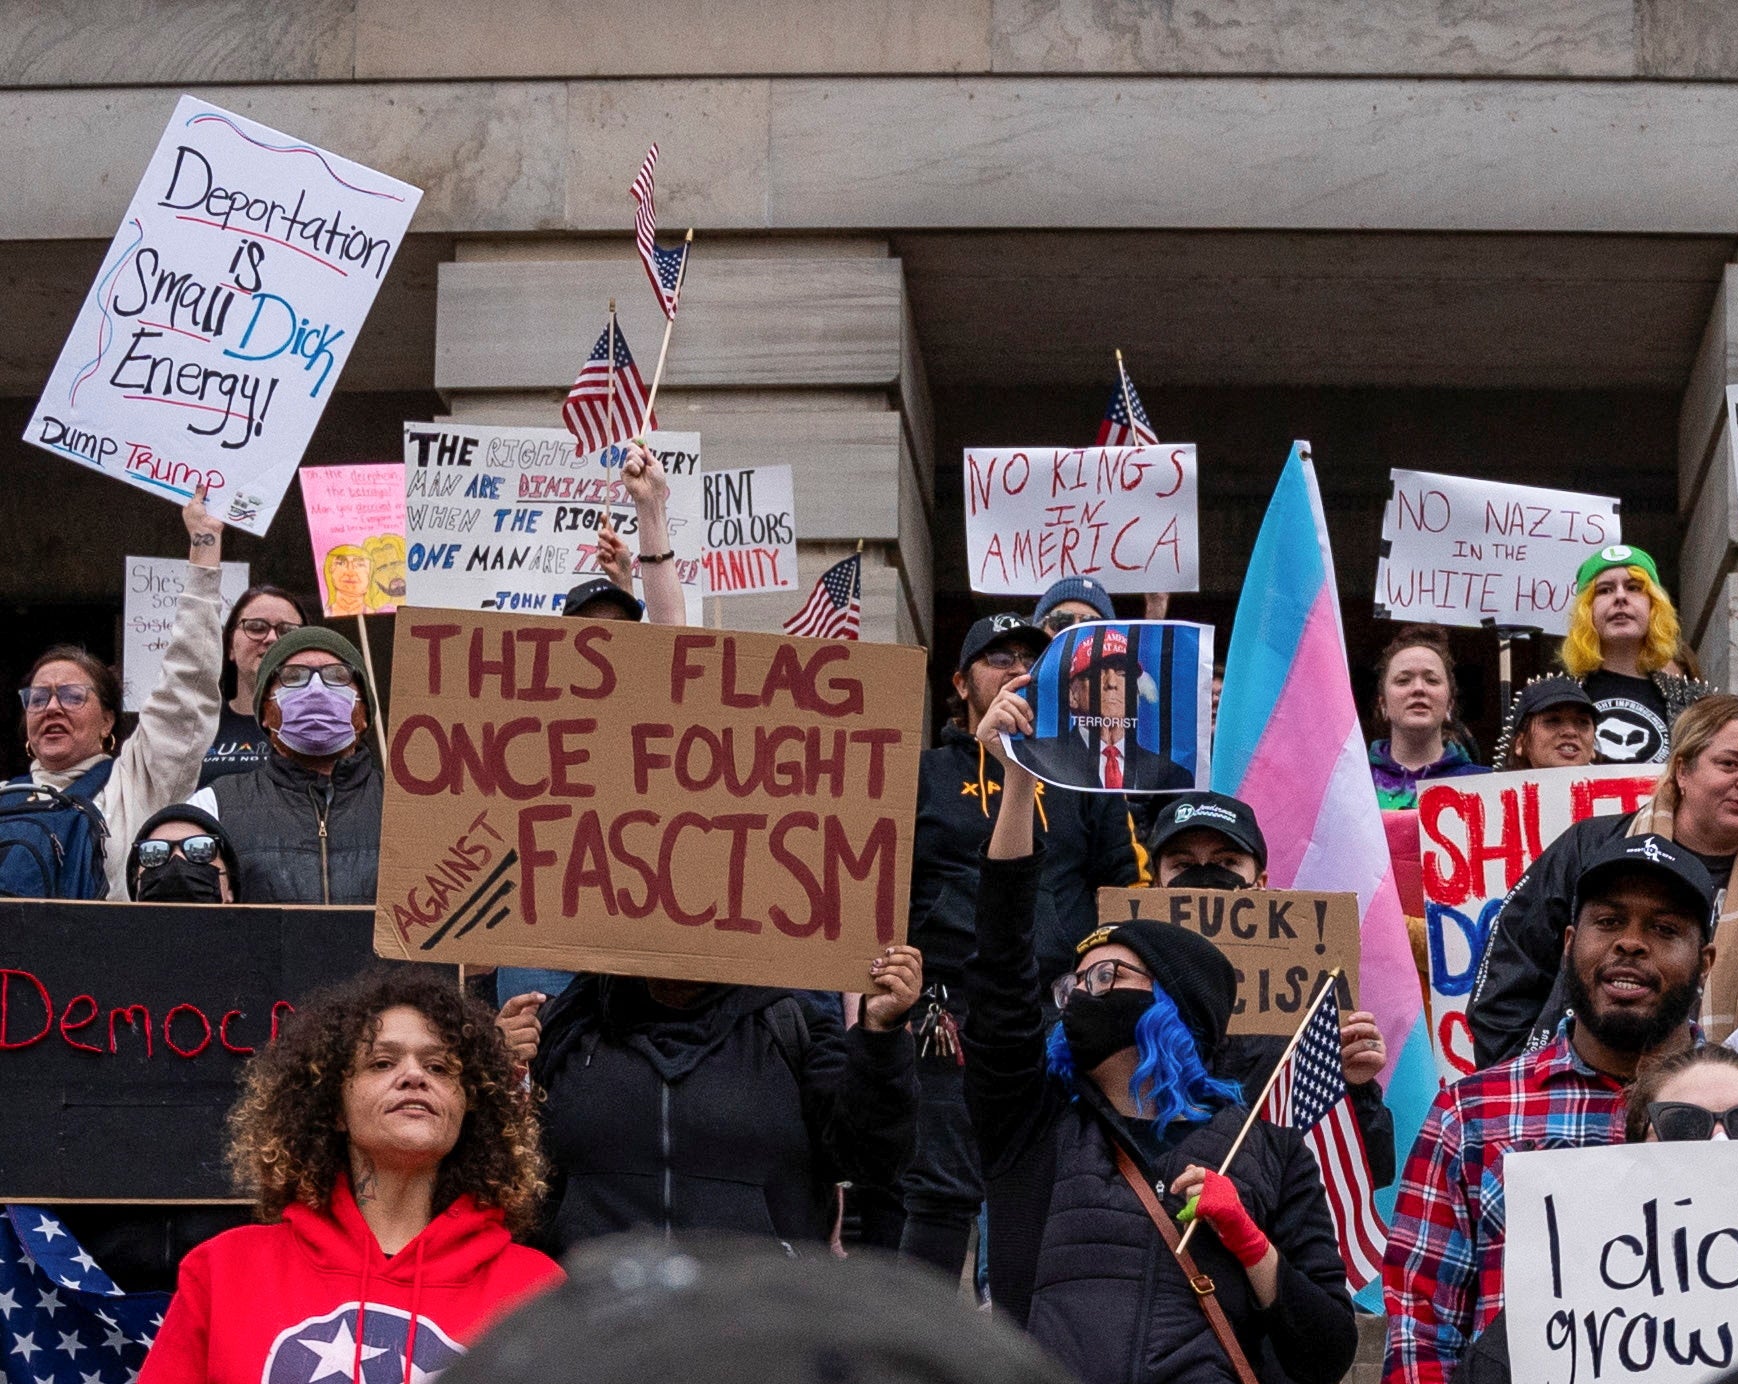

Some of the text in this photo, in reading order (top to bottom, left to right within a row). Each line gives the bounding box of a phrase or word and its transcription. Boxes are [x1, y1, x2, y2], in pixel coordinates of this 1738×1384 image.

[158, 146, 390, 279] Deportation
[228, 239, 265, 292] is
[113, 247, 344, 397] Small Dick
[110, 327, 279, 449] Energy!
[407, 470, 671, 504] MAN ARE DIMINIS
[649, 448, 699, 475] VERY
[968, 448, 1187, 515] NO KINGS
[407, 504, 481, 533] WHEN
[494, 508, 543, 533] THE
[708, 512, 793, 548] COLORS
[1045, 500, 1105, 528] IN
[1399, 490, 1605, 545] NO NAZIS
[408, 543, 462, 572] ONE
[465, 545, 531, 571] MAN
[529, 545, 569, 574] ARE
[981, 513, 1181, 584] AMERICA
[1452, 540, 1527, 561] IN THE
[1387, 568, 1502, 613] WHITE
[411, 624, 864, 716] THIS FLAG
[1071, 716, 1139, 728] TERRORIST
[389, 714, 901, 801] ONCE FOUGHT
[391, 809, 506, 944] AGAINST
[517, 804, 896, 944] FASCISM
[1545, 1195, 1562, 1298] I
